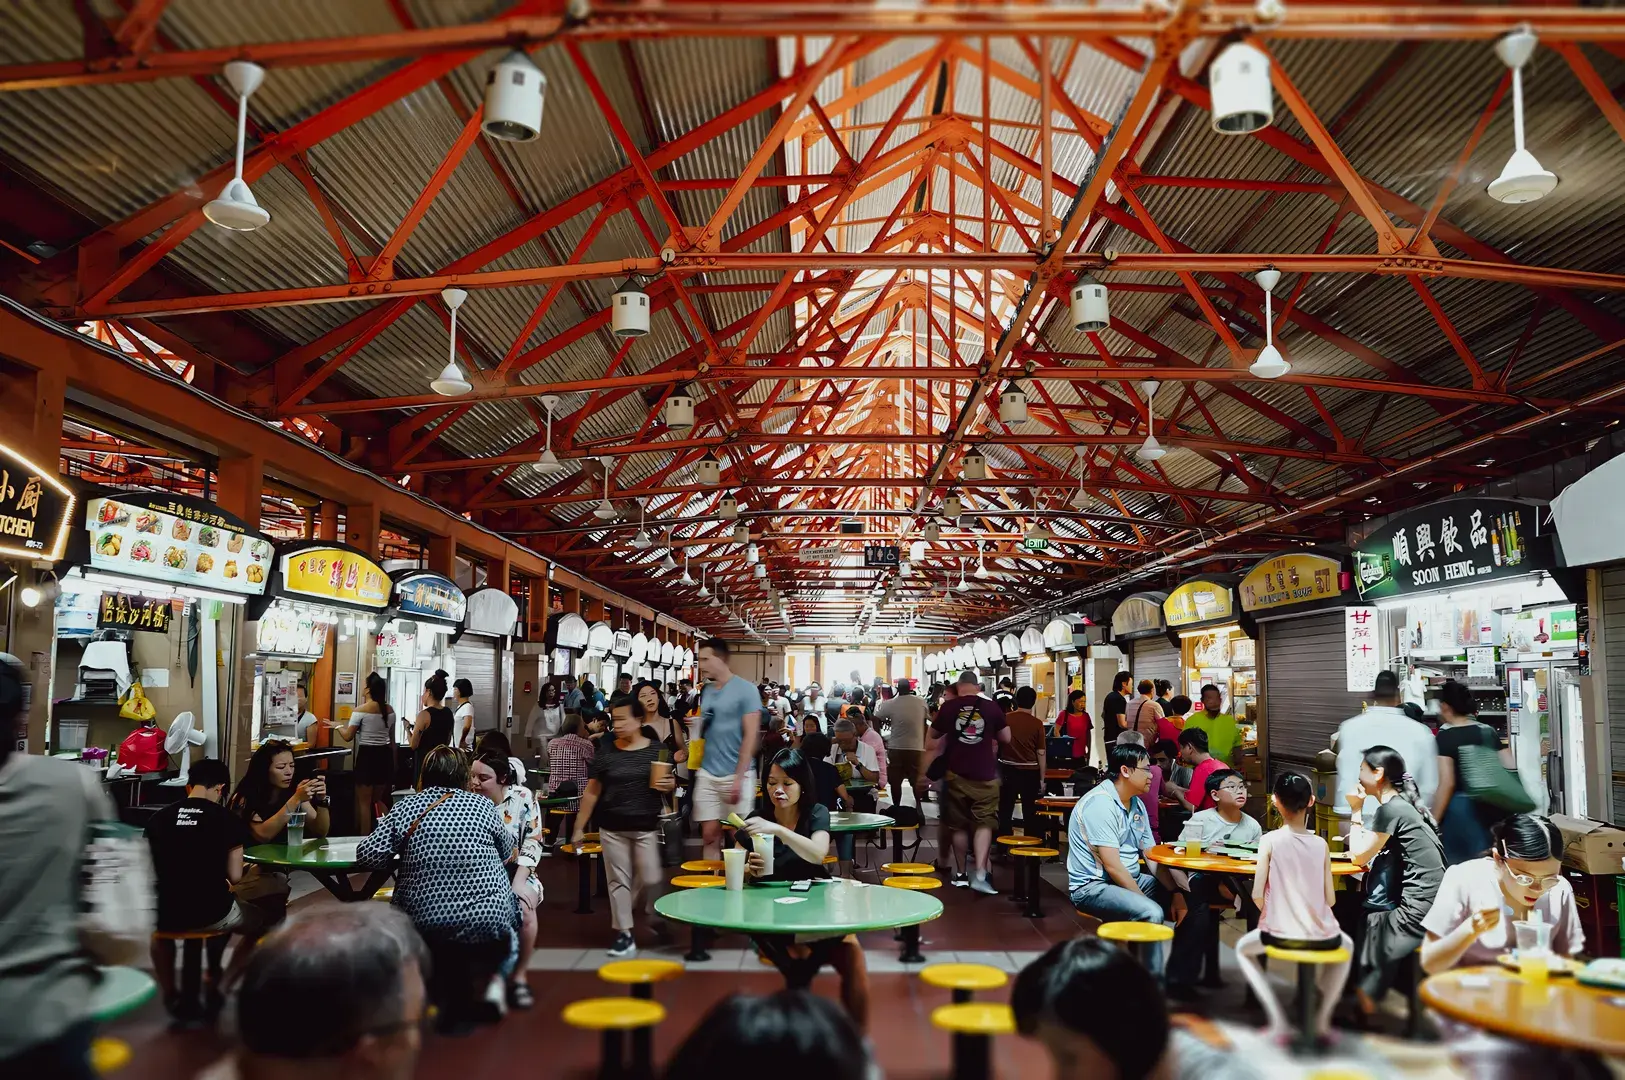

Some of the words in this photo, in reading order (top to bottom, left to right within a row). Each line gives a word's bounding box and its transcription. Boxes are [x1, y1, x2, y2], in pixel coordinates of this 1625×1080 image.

[0, 514, 35, 538] TCHEN
[1412, 565, 1441, 586] SOON
[1443, 559, 1475, 580] HENG
